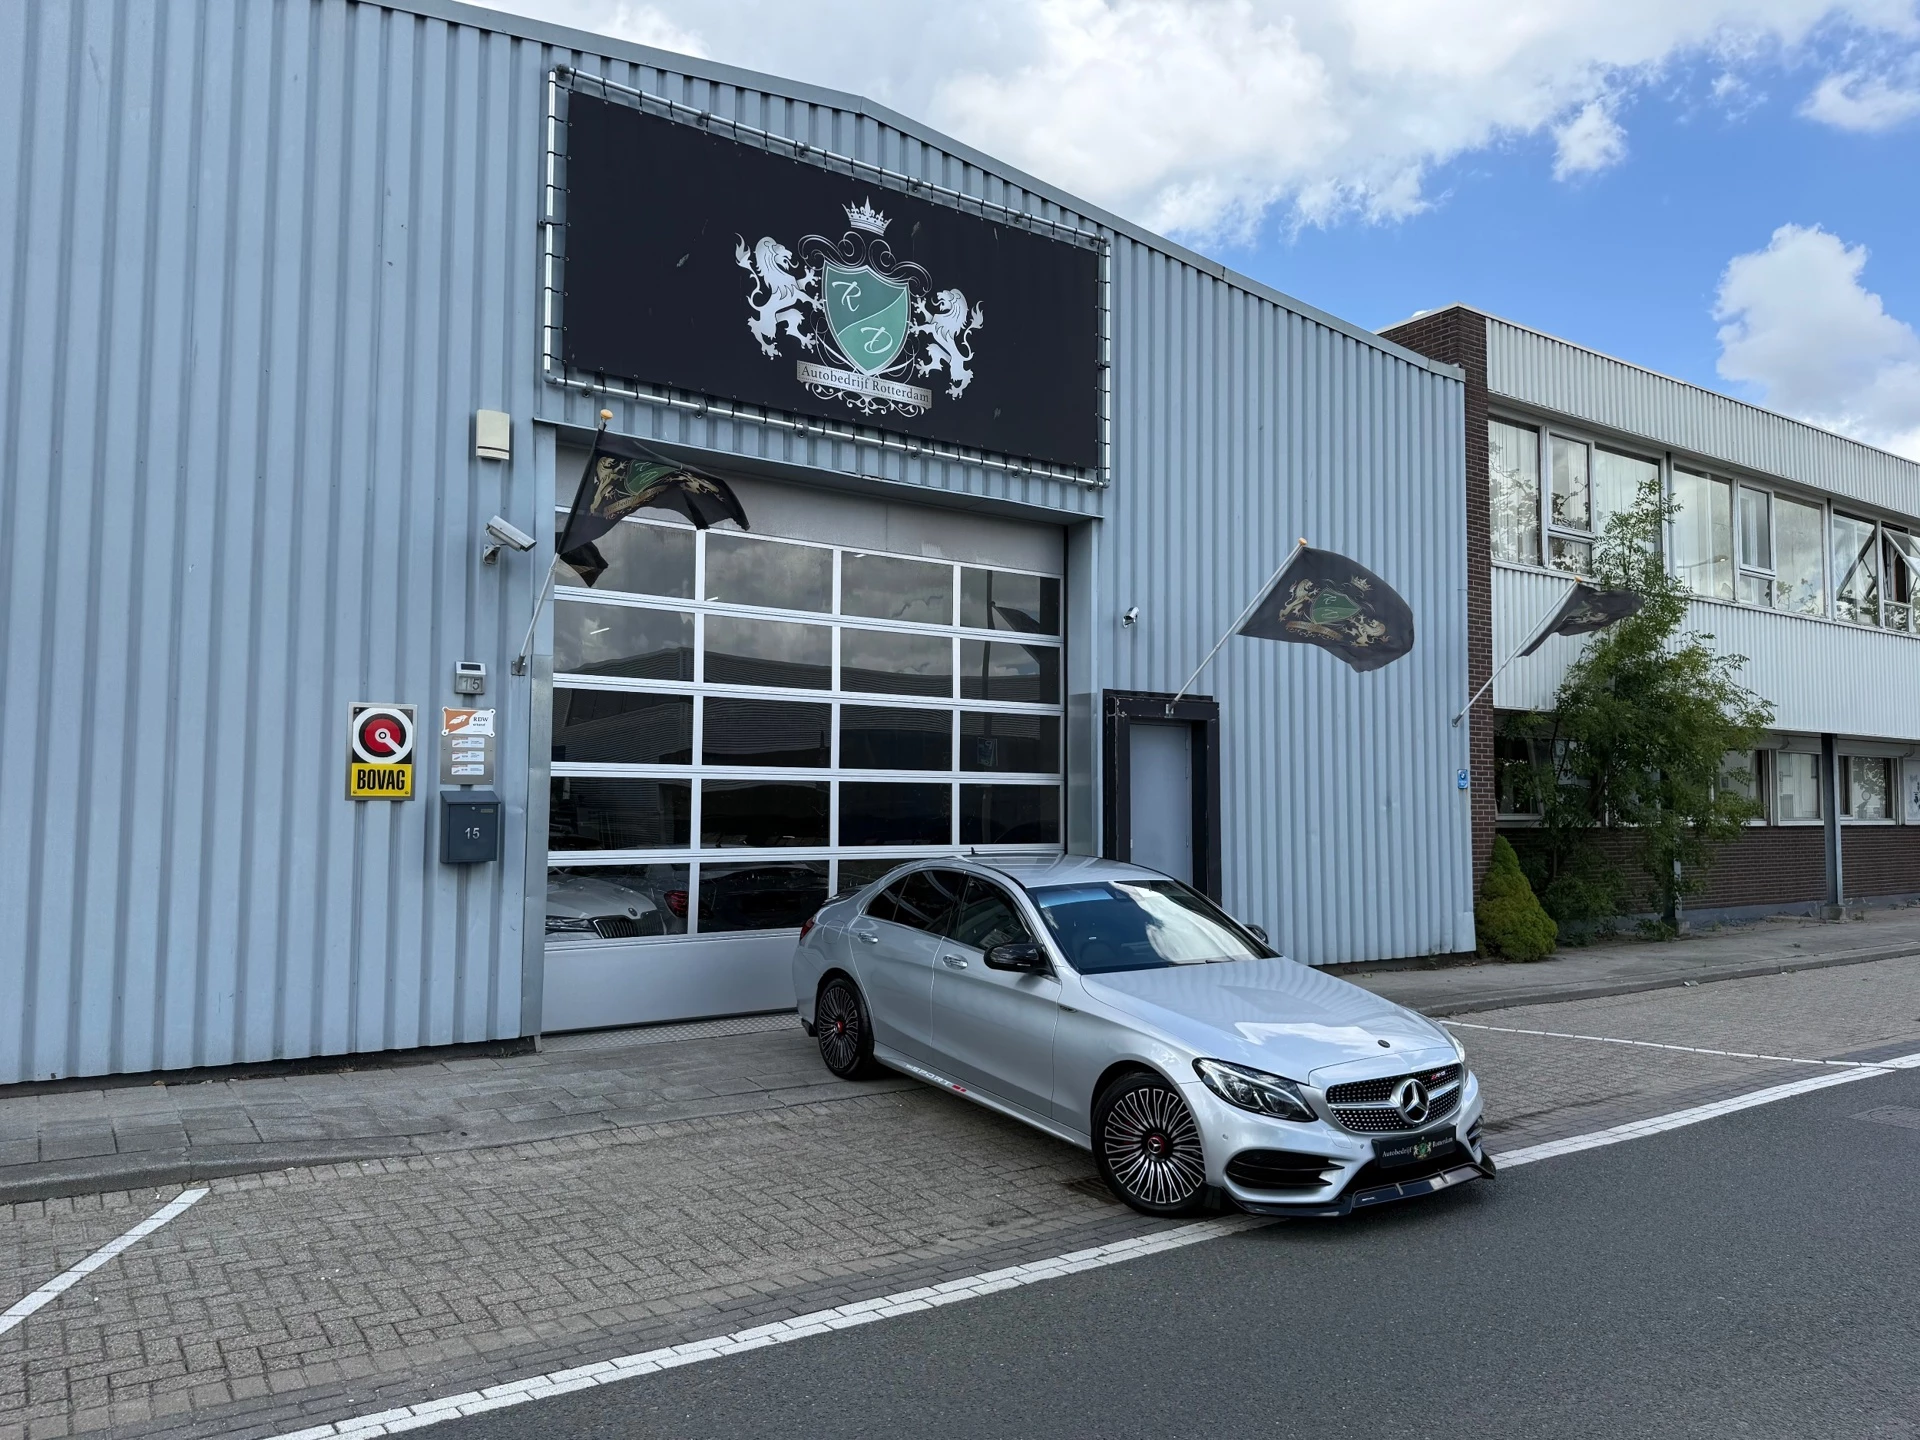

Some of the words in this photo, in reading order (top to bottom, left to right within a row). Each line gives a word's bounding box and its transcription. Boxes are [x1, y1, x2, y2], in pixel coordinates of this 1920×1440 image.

[831, 281, 863, 312] R
[860, 326, 894, 354] D
[801, 366, 869, 390] Autobedrijf
[872, 379, 930, 402] Rotterdam
[463, 678, 480, 691] 15
[357, 768, 406, 791] BOVAG
[464, 827, 480, 839] 15
[1381, 1145, 1413, 1158] Autobedrijf
